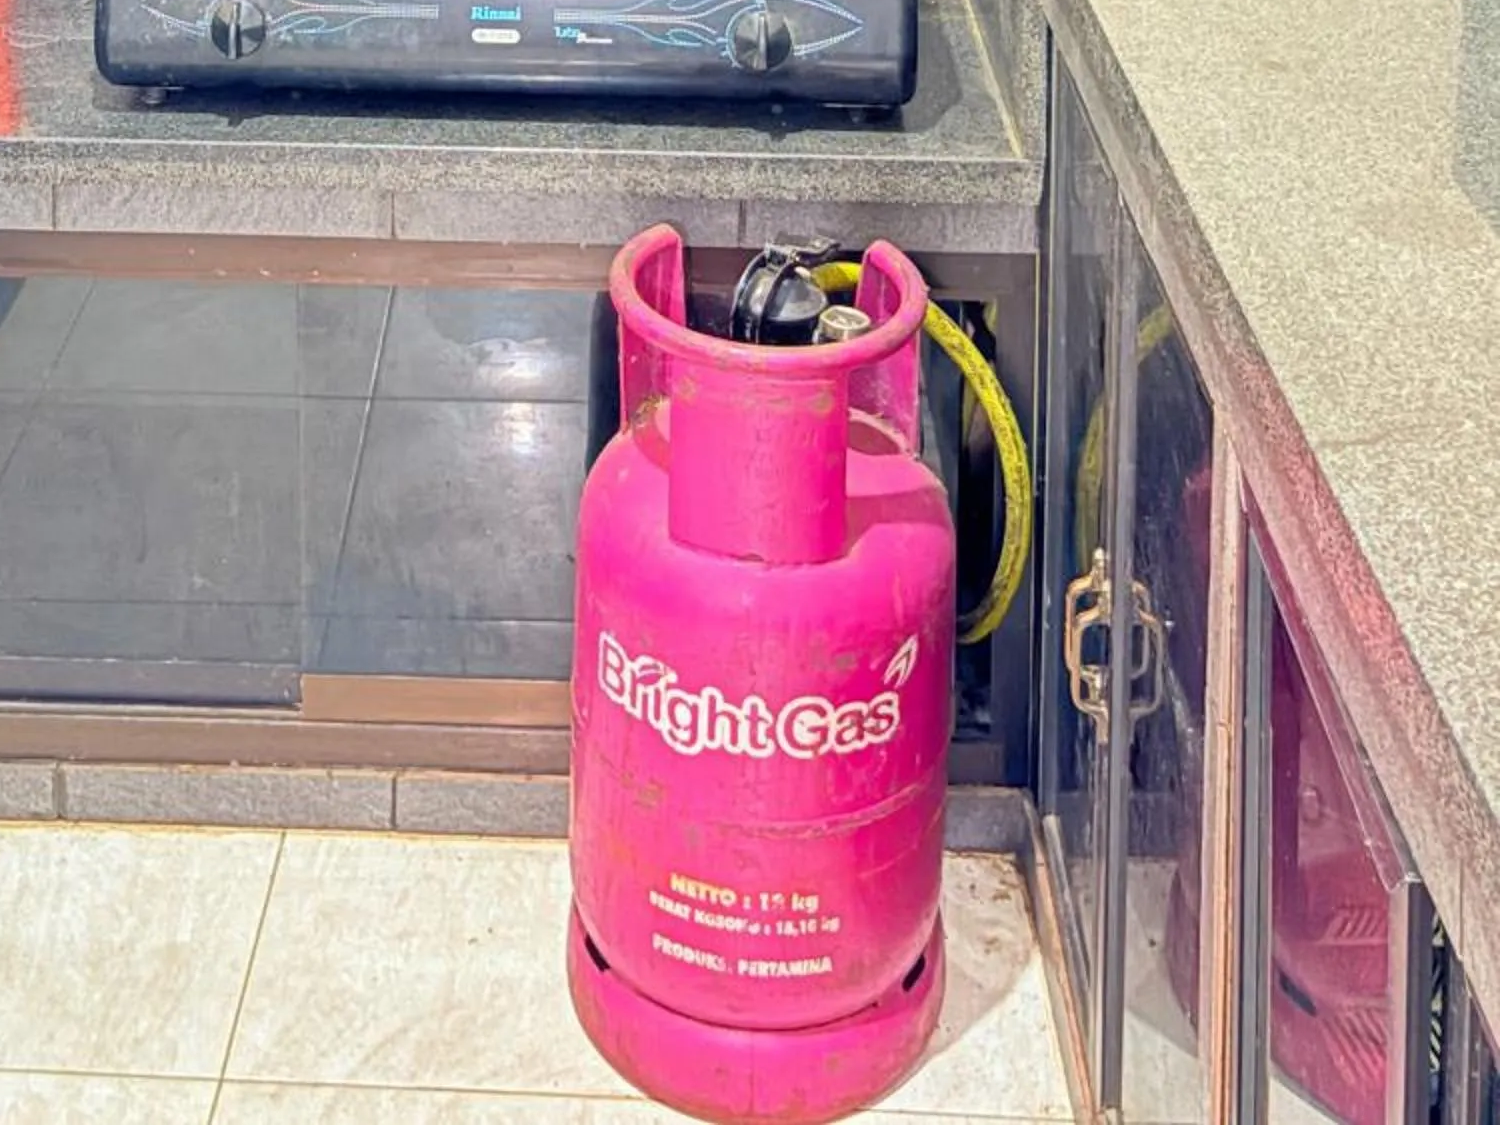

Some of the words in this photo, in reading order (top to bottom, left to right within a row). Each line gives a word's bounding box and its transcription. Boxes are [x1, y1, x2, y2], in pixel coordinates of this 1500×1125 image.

[471, 5, 521, 21] Rinnai
[599, 631, 777, 758] Bright
[775, 689, 900, 758] Gas
[670, 871, 737, 907] NETTO
[791, 892, 819, 914] kg
[737, 955, 833, 978] PERTAMINA
